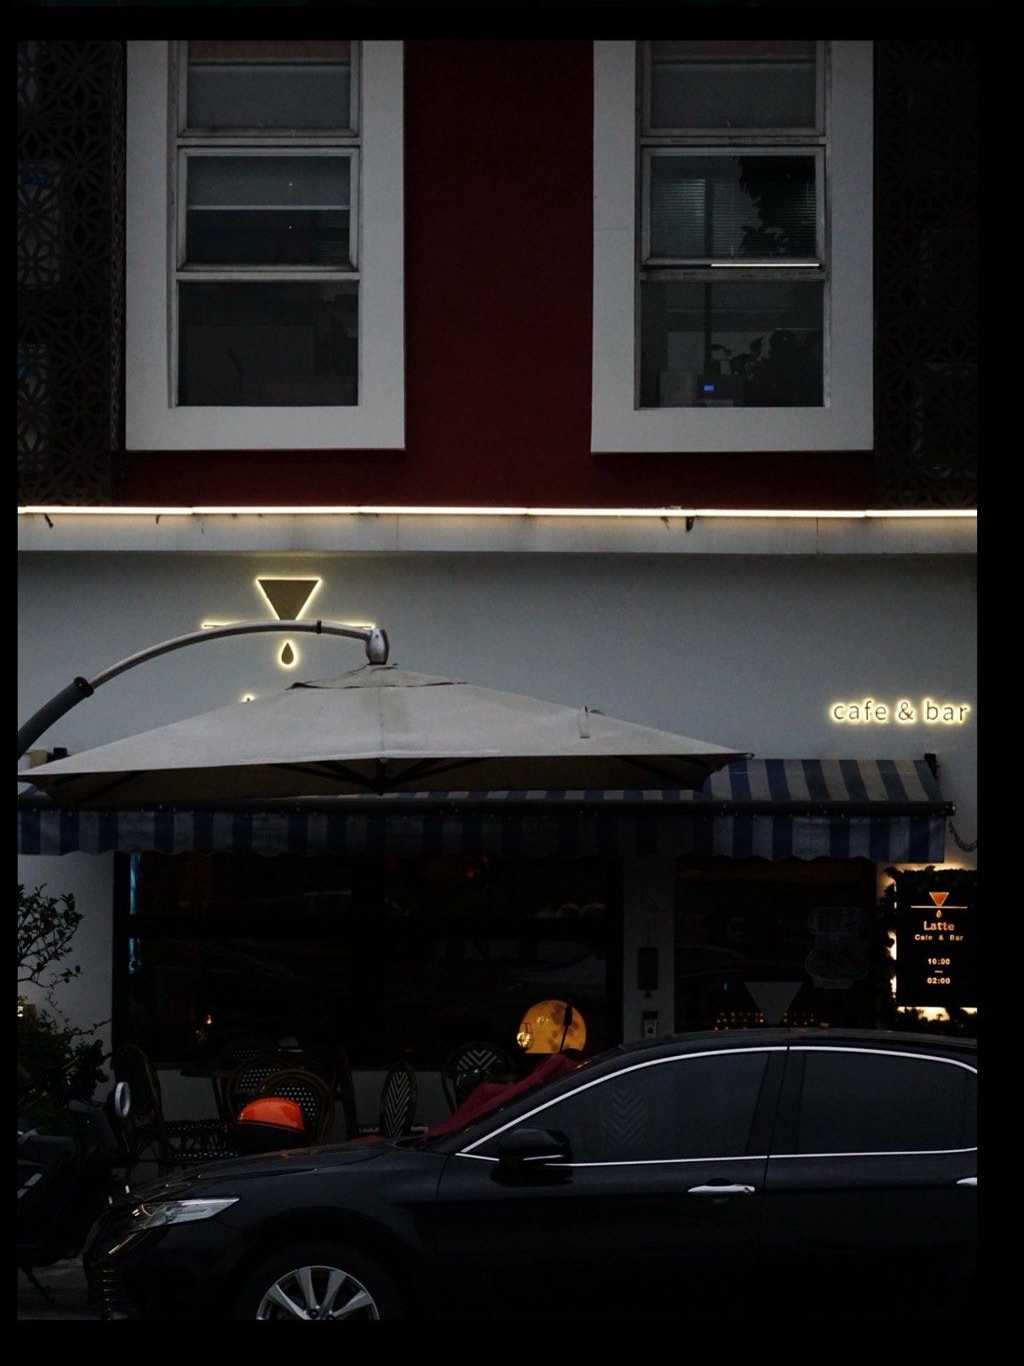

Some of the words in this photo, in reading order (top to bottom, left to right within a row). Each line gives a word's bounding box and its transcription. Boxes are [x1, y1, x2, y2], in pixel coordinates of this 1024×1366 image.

[831, 699, 888, 723] cafe
[896, 700, 915, 723] &
[924, 699, 970, 723] bar
[923, 920, 955, 932] Latte
[914, 933, 933, 941] Cafe
[949, 933, 964, 941] Bar
[927, 957, 951, 965] 10:00
[926, 977, 951, 985] 02:00
